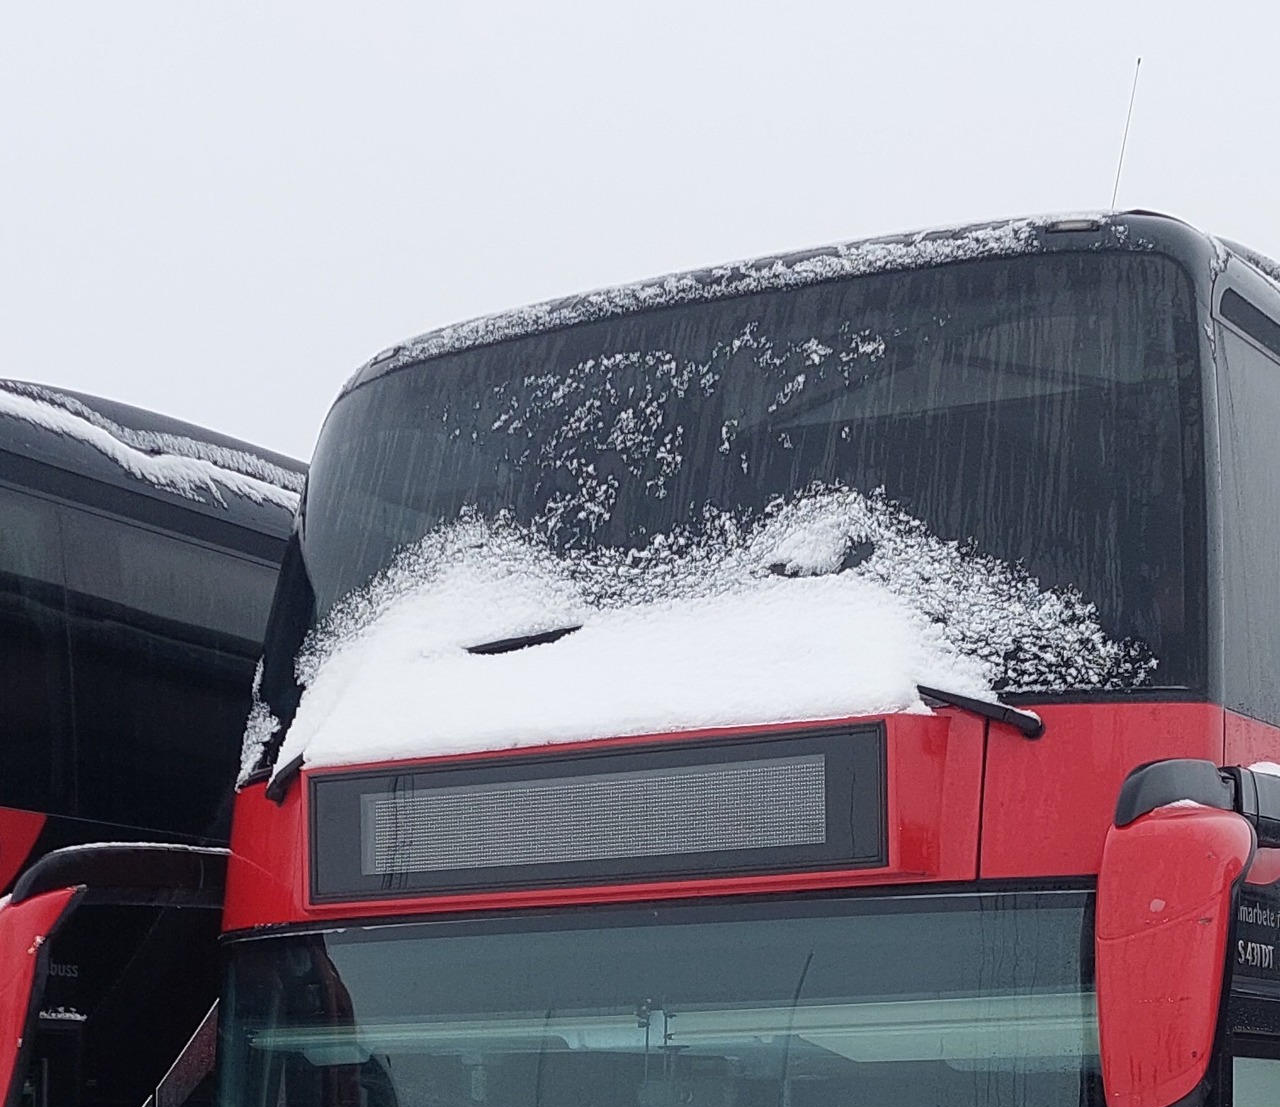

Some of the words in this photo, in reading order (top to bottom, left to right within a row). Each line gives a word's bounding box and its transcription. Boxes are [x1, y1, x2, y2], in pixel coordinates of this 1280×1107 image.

[1237, 939, 1245, 964] S
[1245, 941, 1260, 967] 431
[1260, 944, 1274, 969] DT
[46, 959, 79, 978] buss
